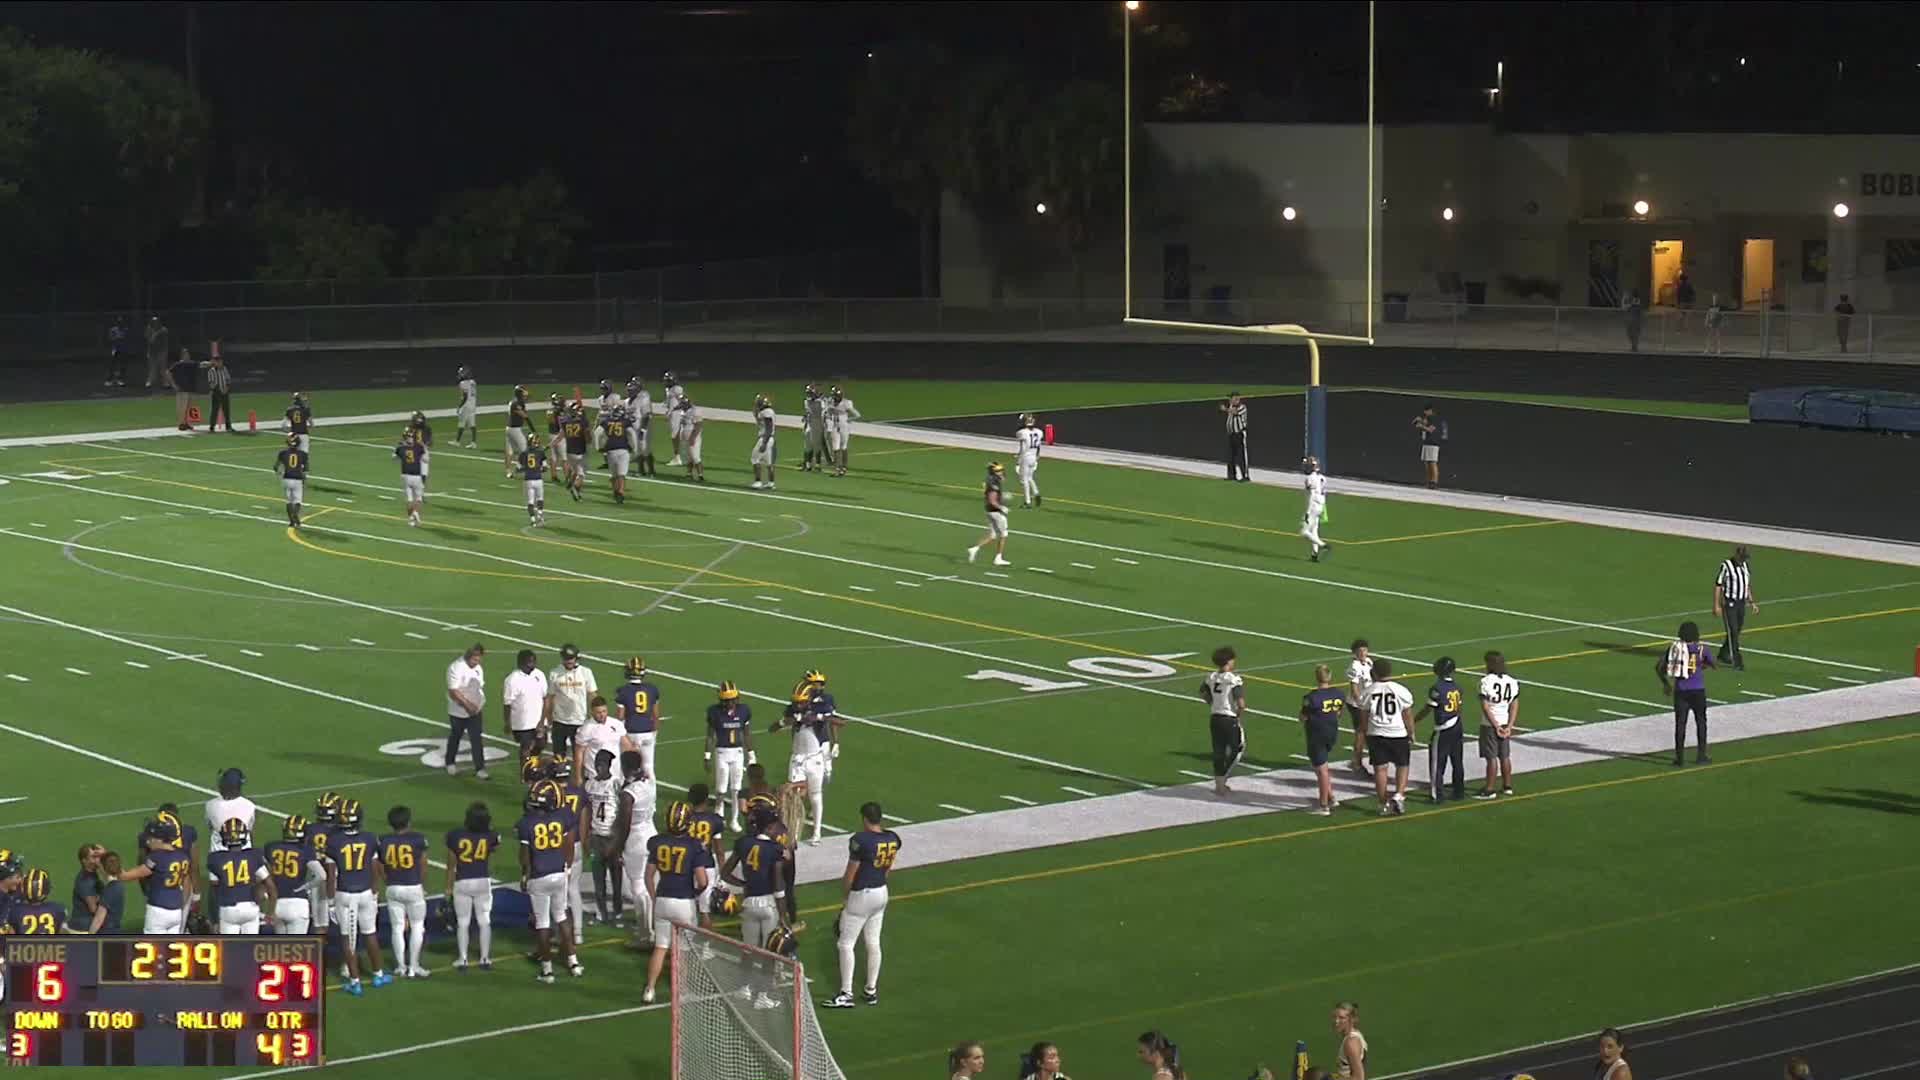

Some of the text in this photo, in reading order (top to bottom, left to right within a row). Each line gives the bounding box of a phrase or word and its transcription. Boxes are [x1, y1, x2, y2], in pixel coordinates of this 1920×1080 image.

[1862, 174, 1920, 196] BOB
[1029, 432, 1040, 449] 12
[289, 454, 298, 468] 0
[962, 656, 1177, 692] 10
[635, 690, 648, 713] 9
[1371, 692, 1396, 716] 76
[1492, 682, 1511, 704] 34
[596, 802, 605, 822] 4
[534, 822, 562, 849] 83
[340, 842, 367, 871] 17
[385, 843, 414, 869] 46
[458, 838, 488, 863] 24
[656, 845, 687, 874] 97
[746, 844, 760, 871] 4
[222, 858, 250, 888] 14
[271, 849, 299, 878] 35
[22, 912, 55, 935] 23
